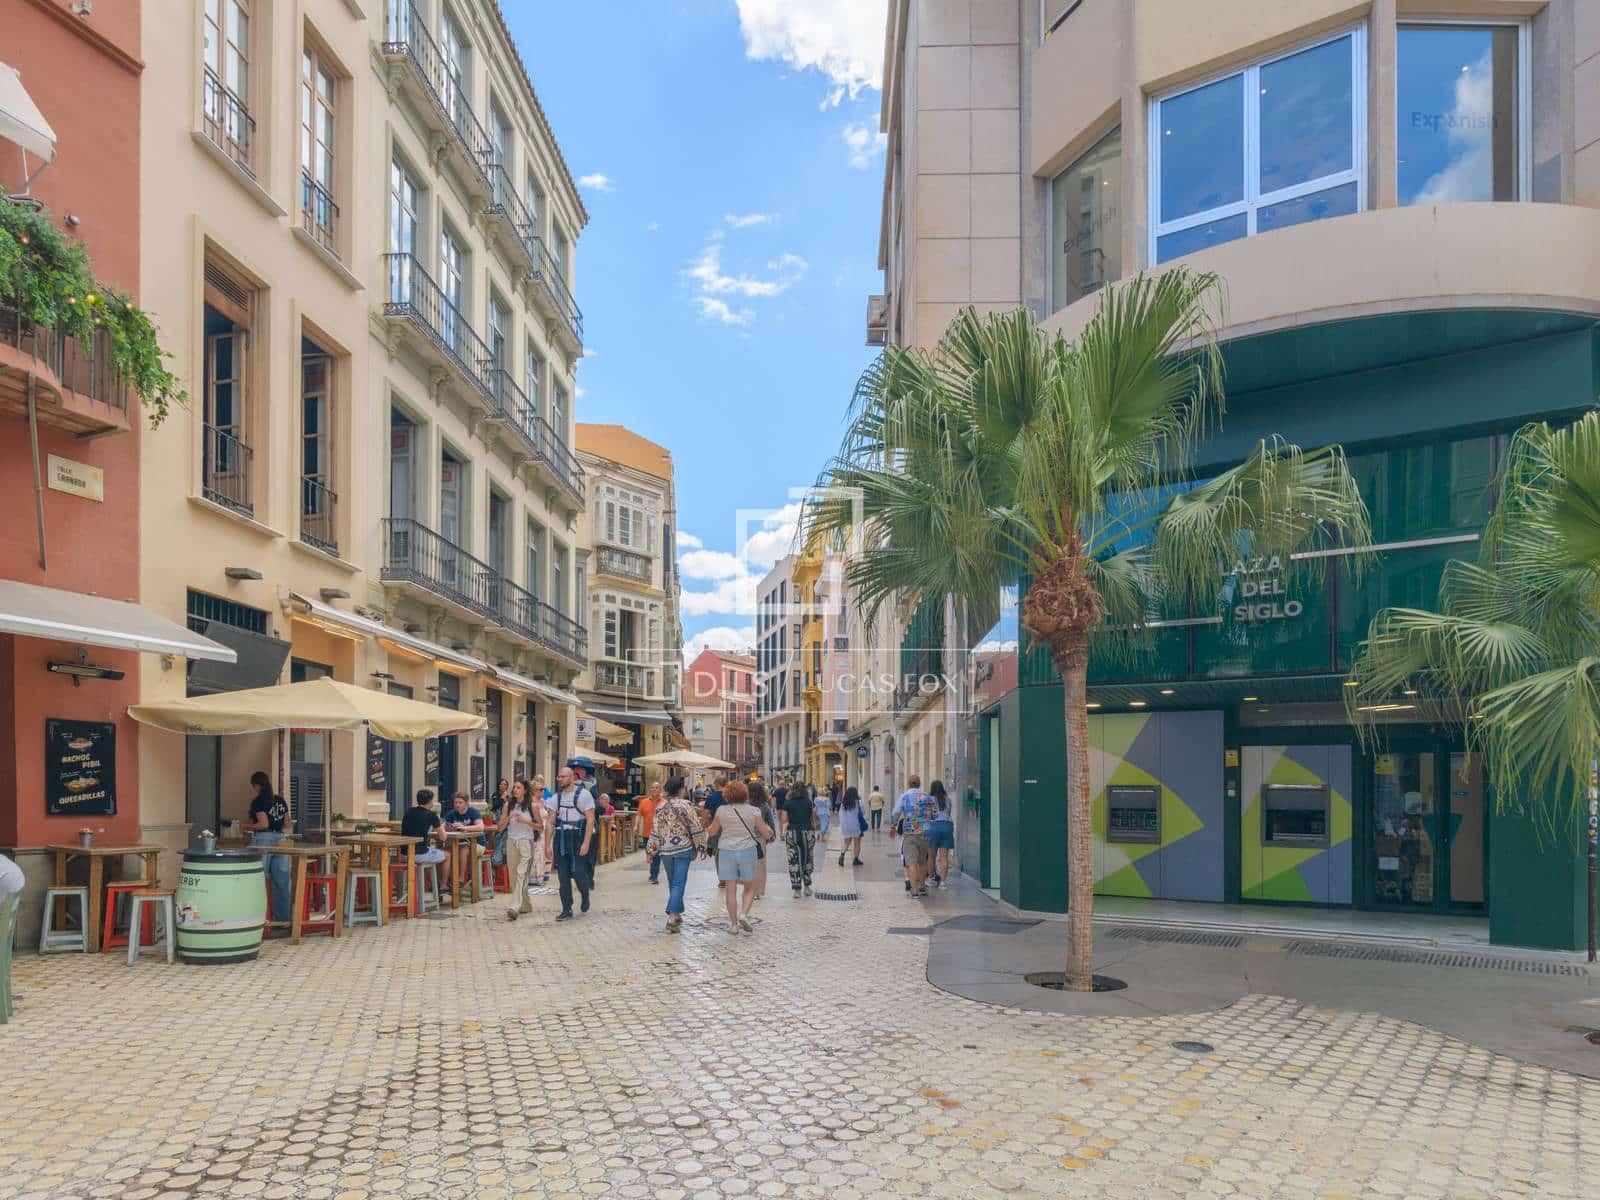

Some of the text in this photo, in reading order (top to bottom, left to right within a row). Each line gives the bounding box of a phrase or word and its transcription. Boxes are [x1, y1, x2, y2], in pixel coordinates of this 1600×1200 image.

[1411, 111, 1503, 135] Expanish
[1209, 555, 1281, 577] LAZA
[1242, 579, 1285, 597] DEL
[1234, 600, 1303, 621] SIGLO
